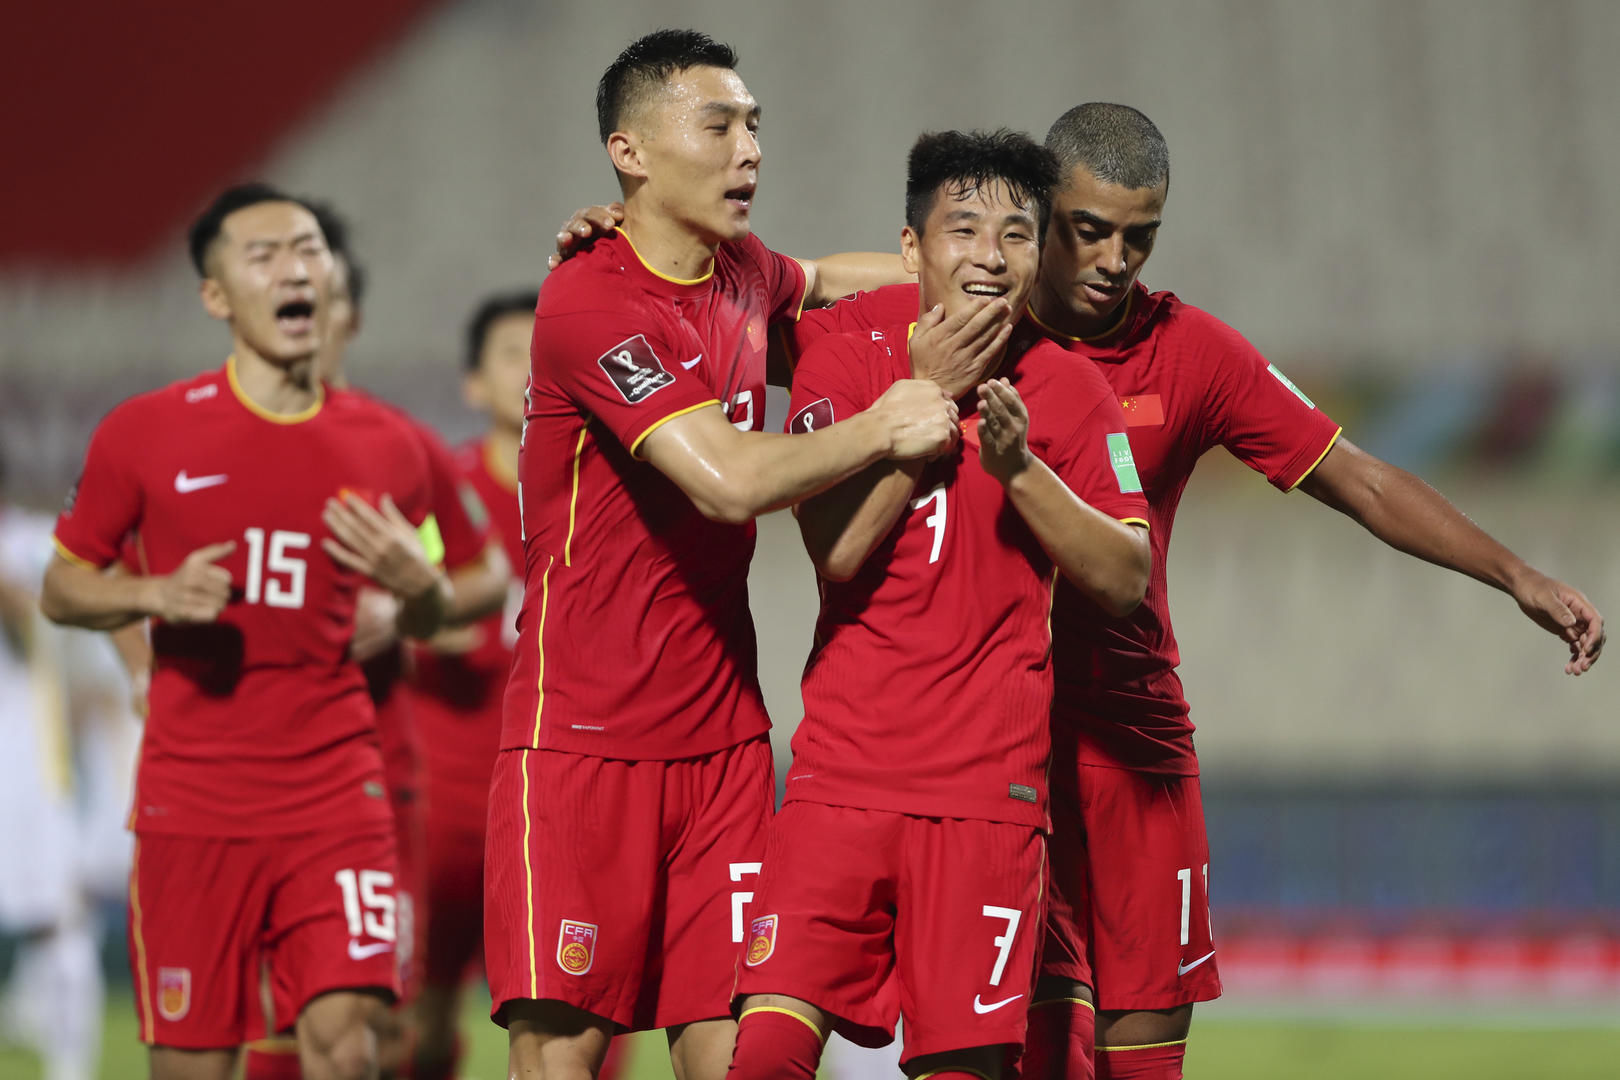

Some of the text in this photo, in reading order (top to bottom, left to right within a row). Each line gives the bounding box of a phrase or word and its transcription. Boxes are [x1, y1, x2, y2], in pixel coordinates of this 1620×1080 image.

[910, 482, 947, 564] 7
[244, 527, 311, 609] 15
[335, 868, 396, 942] 15
[565, 924, 593, 938] CFA
[1177, 863, 1213, 946] 11
[983, 905, 1022, 986] 7
